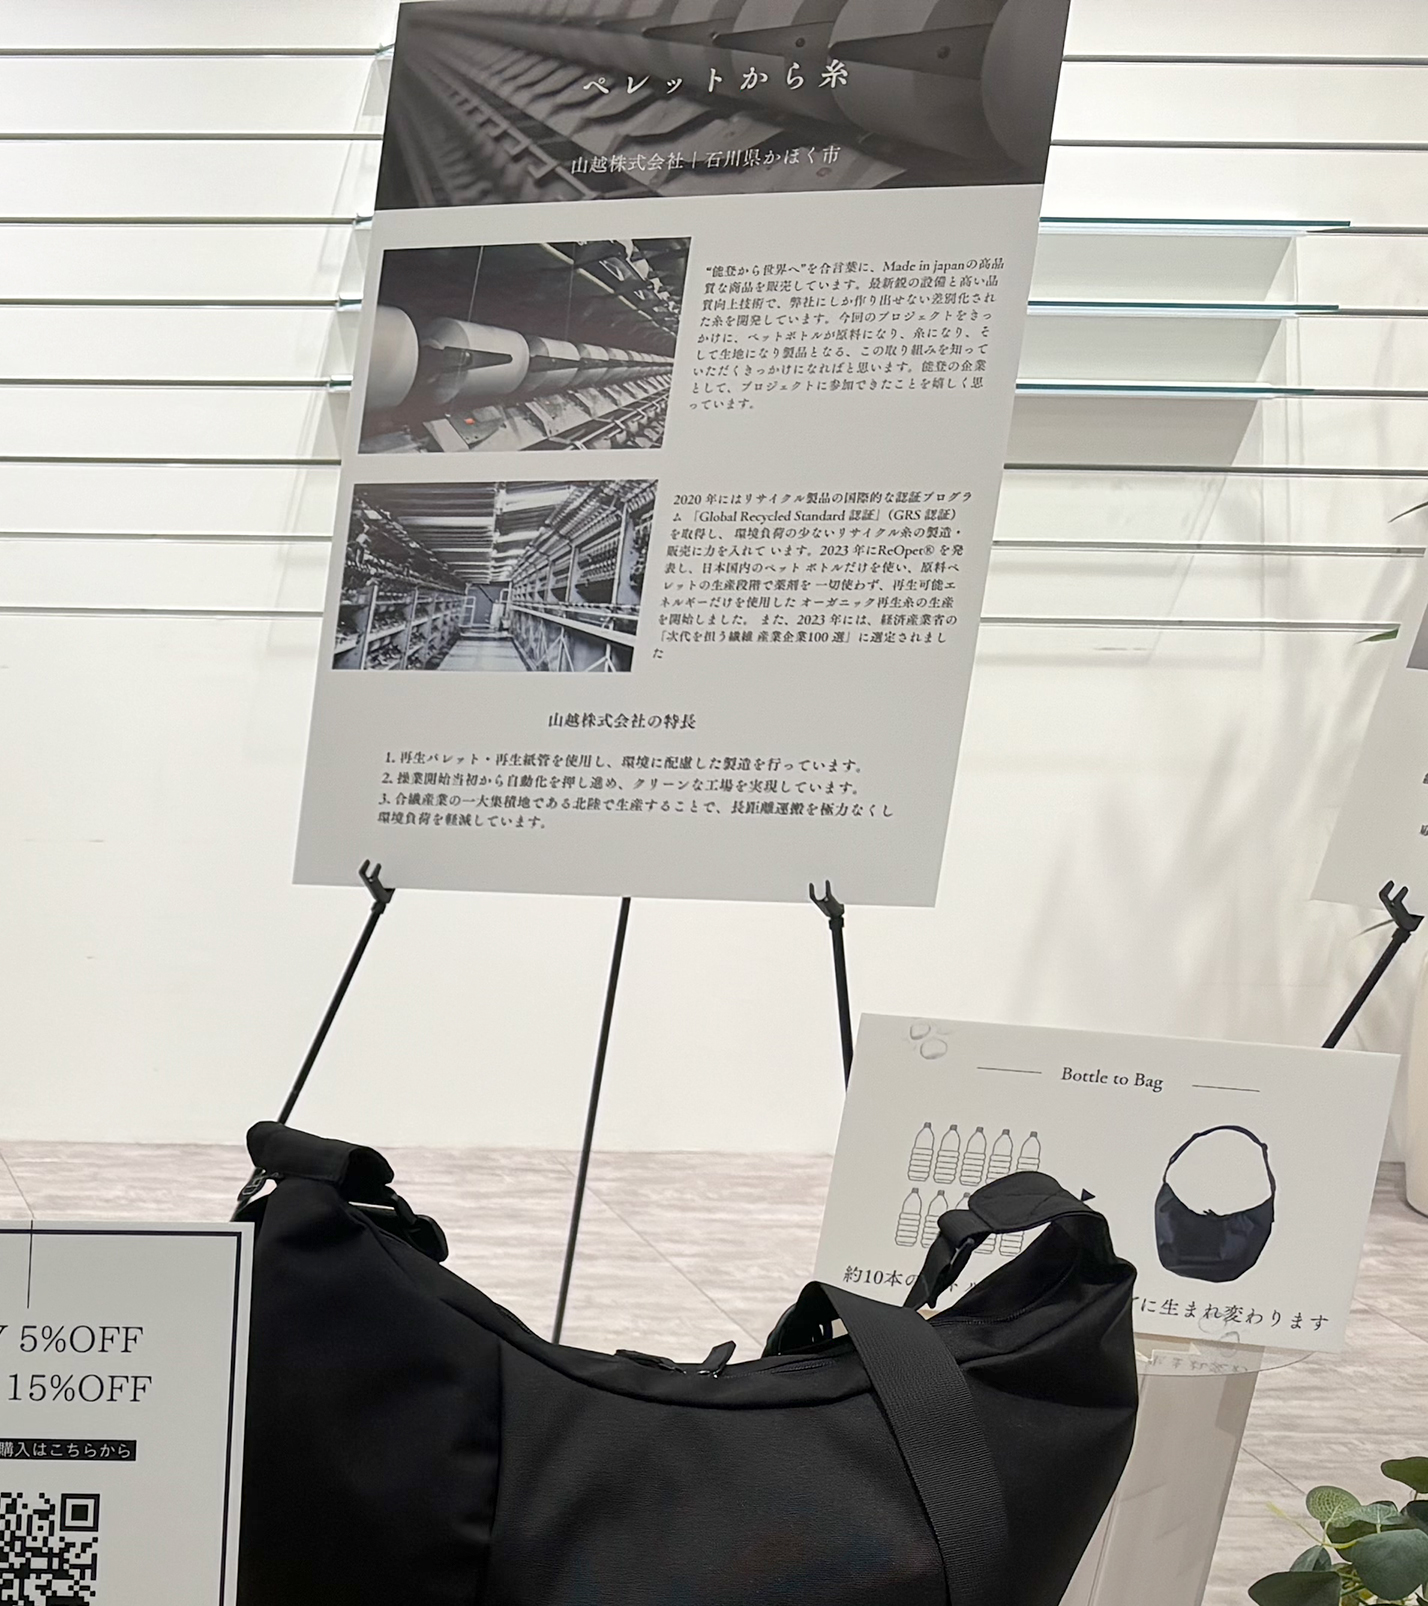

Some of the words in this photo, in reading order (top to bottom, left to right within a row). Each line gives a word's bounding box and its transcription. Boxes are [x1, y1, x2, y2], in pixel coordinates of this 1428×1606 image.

[583, 58, 850, 96] ペレットから糸
[919, 260, 930, 271] in
[690, 398, 753, 410] っています。
[674, 495, 701, 505] 2020
[741, 510, 791, 524] Recycled
[794, 510, 846, 521] Standard
[549, 712, 696, 729] 山越株式会社の特長
[1061, 1067, 1108, 1087] Bottle
[1113, 1073, 1130, 1088] to
[1135, 1073, 1164, 1093] Bag
[1132, 1297, 1329, 1331] に生まれ変わります
[19, 1325, 144, 1354] 5%OFF
[8, 1374, 153, 1402] 15%OFF
